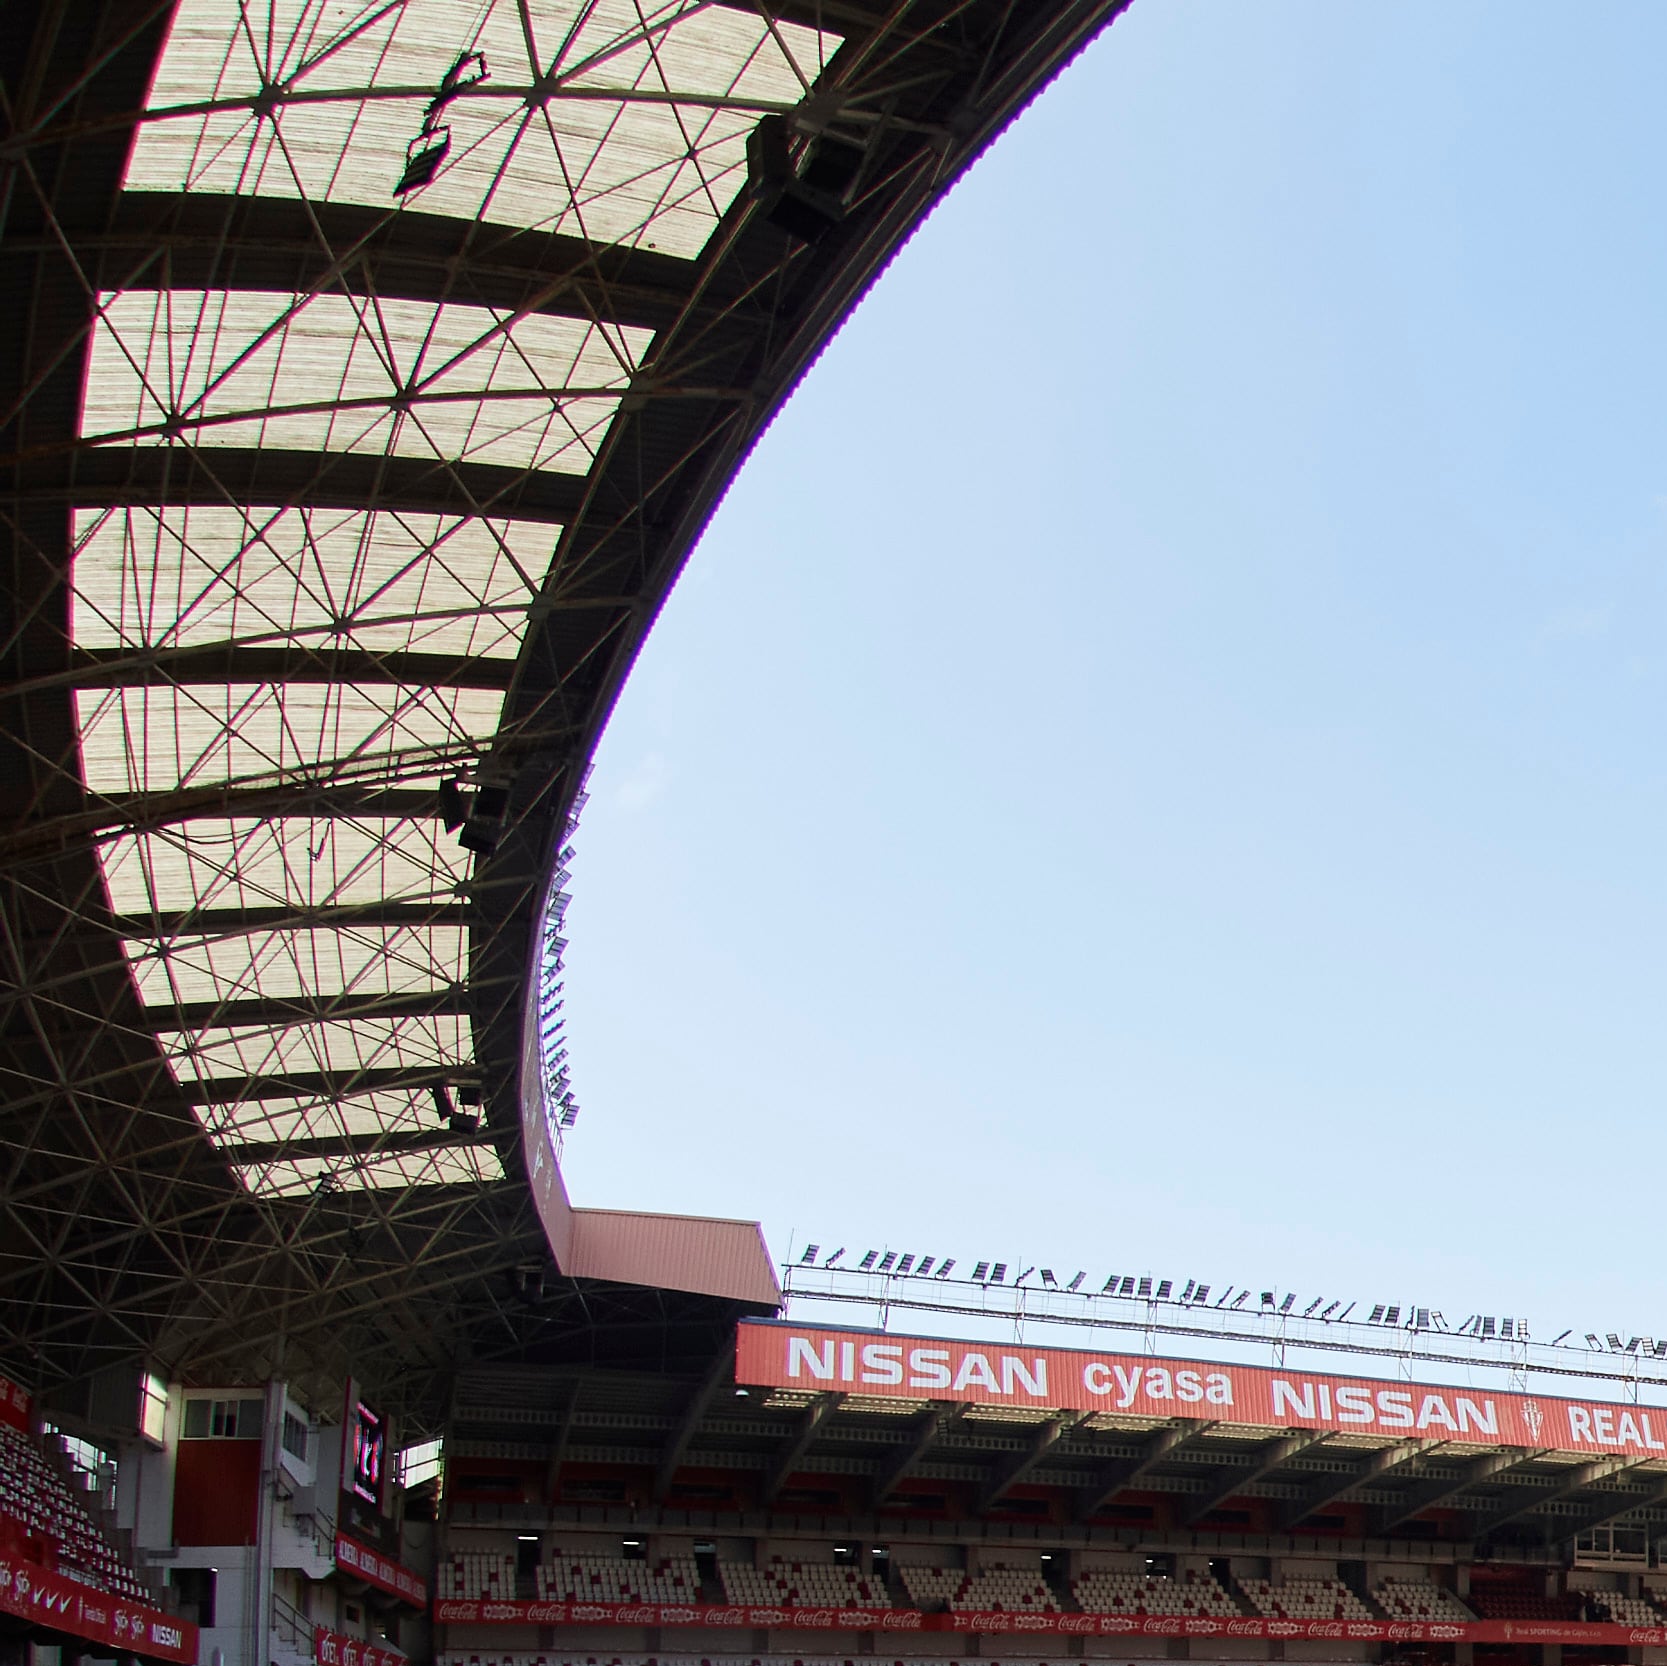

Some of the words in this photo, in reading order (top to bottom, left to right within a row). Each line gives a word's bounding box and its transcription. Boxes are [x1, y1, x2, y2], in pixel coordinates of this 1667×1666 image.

[787, 1337, 1048, 1398] NISSAN
[1084, 1361, 1234, 1409] cyasa
[1272, 1379, 1498, 1436] NISSAN
[1569, 1405, 1665, 1451] REAL
[150, 1623, 182, 1649] NISSAN
